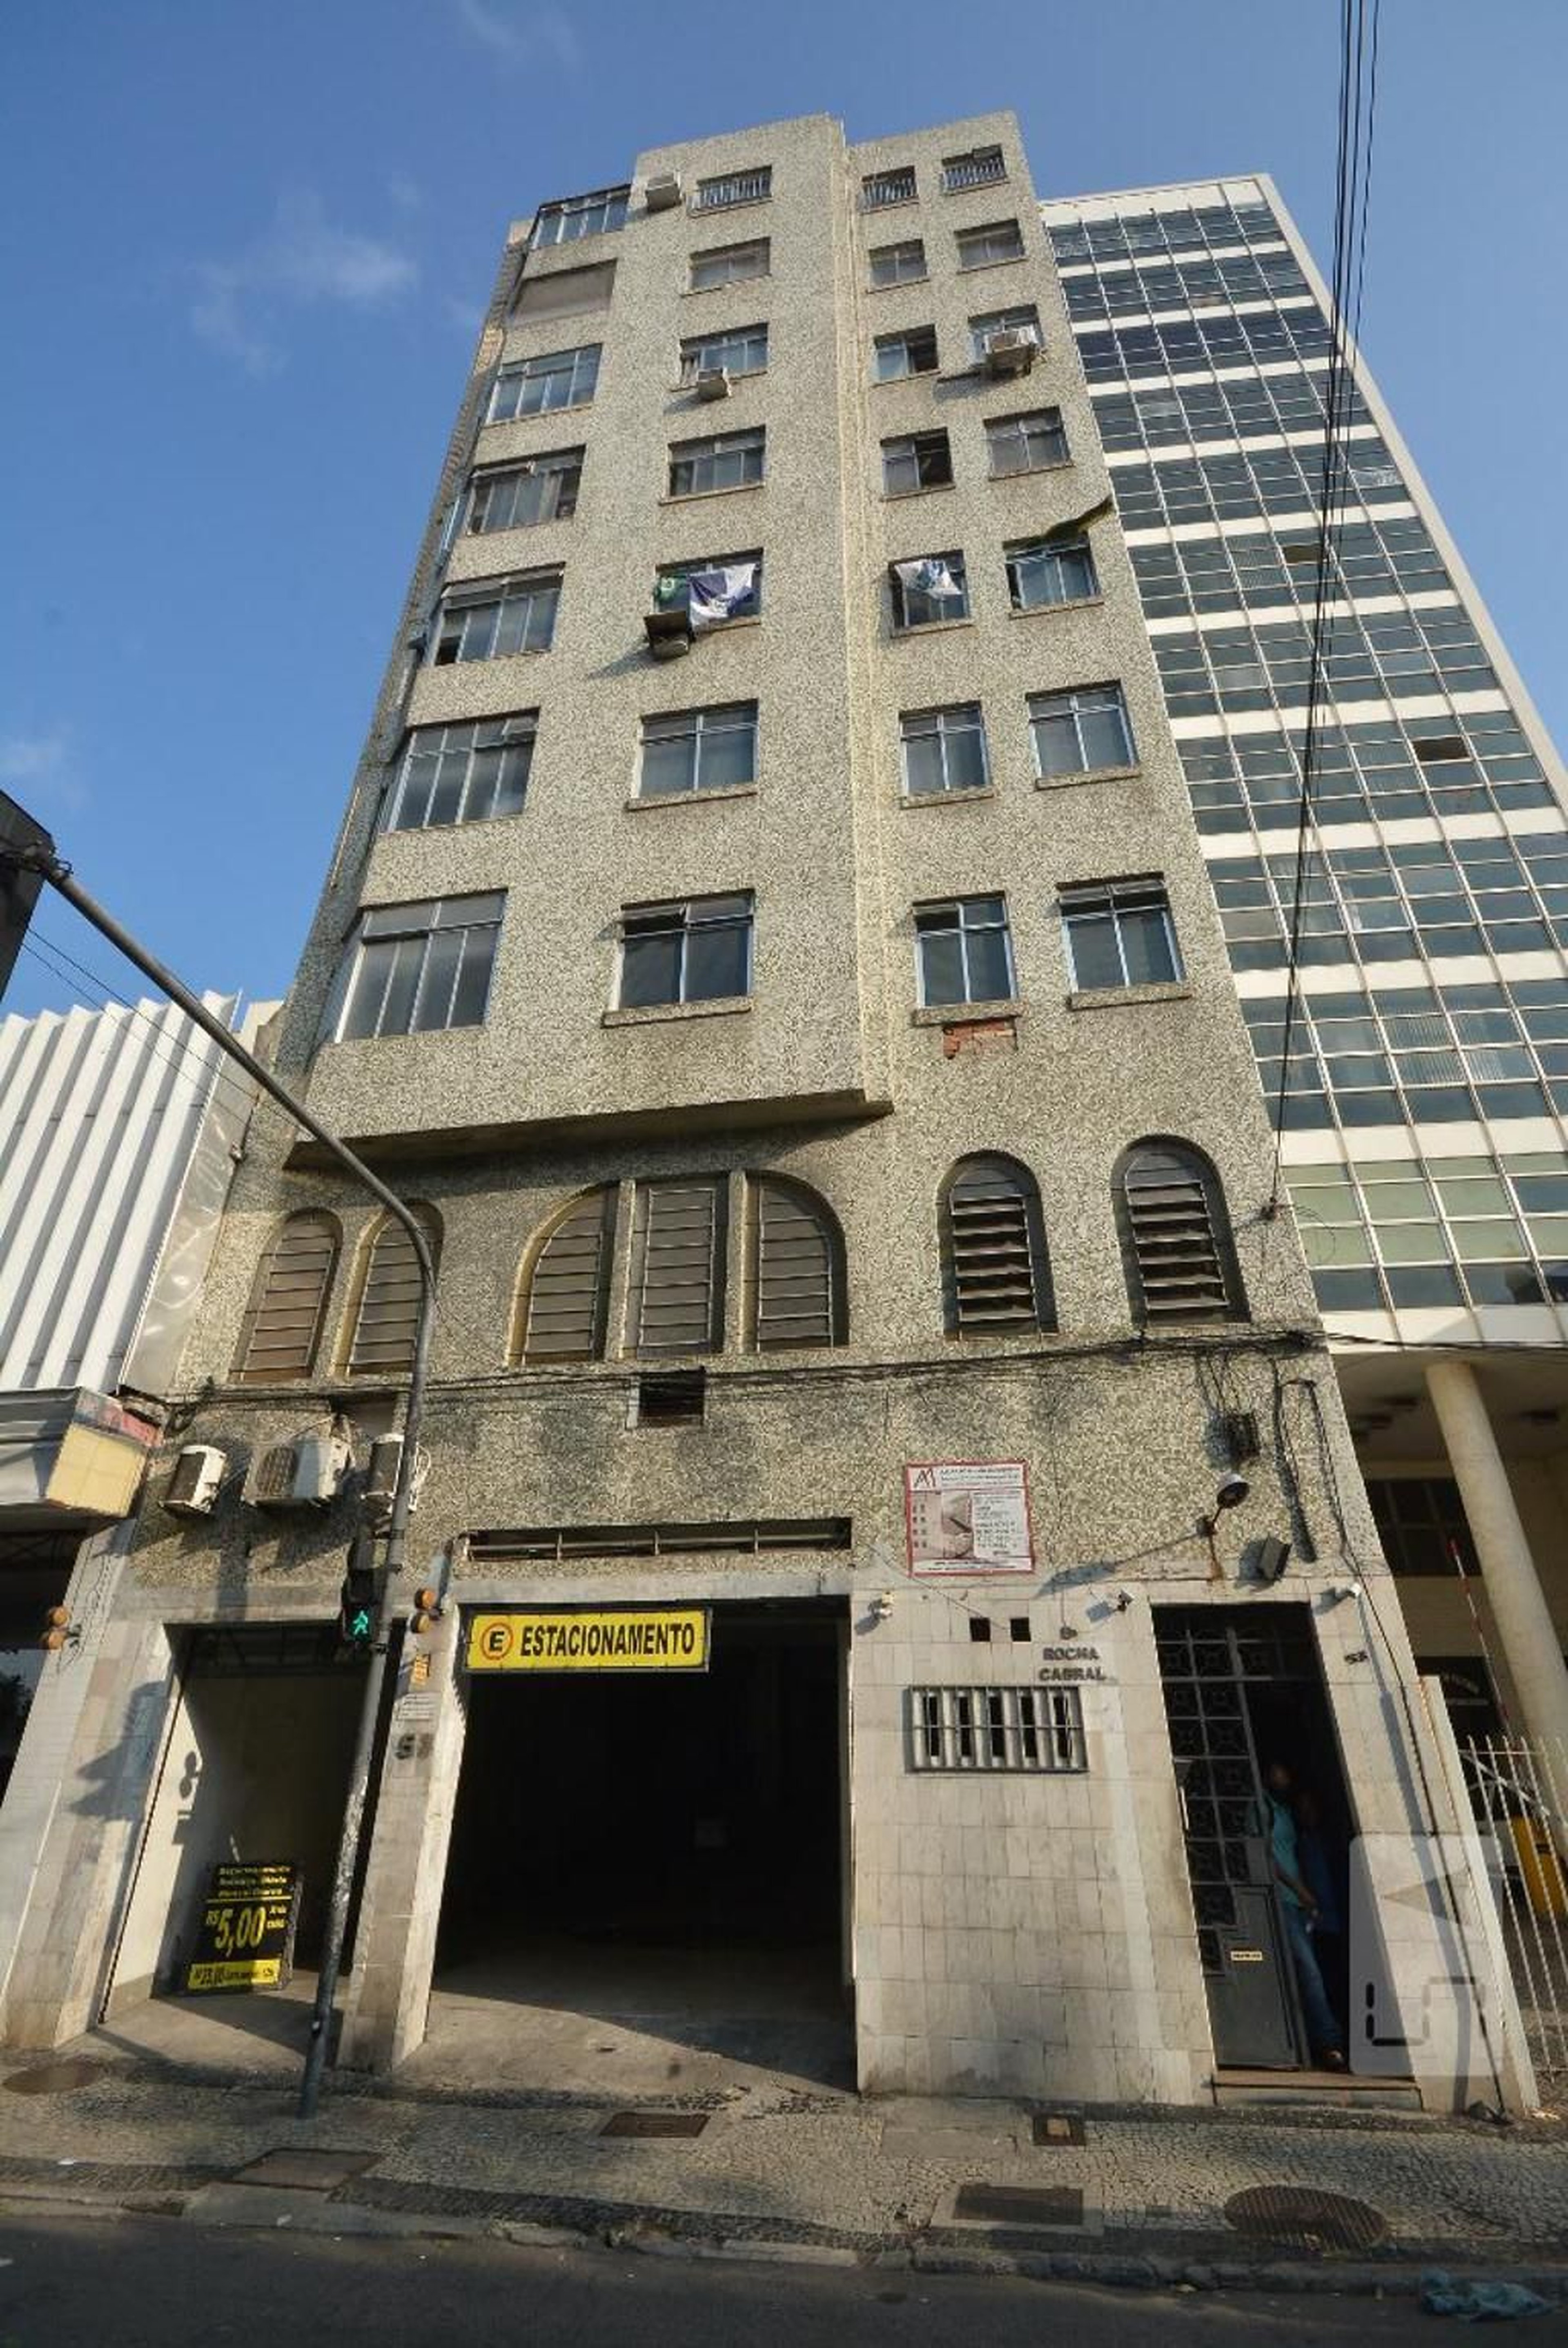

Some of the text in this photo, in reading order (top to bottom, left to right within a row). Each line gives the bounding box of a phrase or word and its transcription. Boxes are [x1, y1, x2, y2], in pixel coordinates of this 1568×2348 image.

[521, 1623, 695, 1656] ESTACIONAMENTO
[1039, 1666, 1106, 1681] CABRAL
[215, 1907, 265, 1957] 5,00
